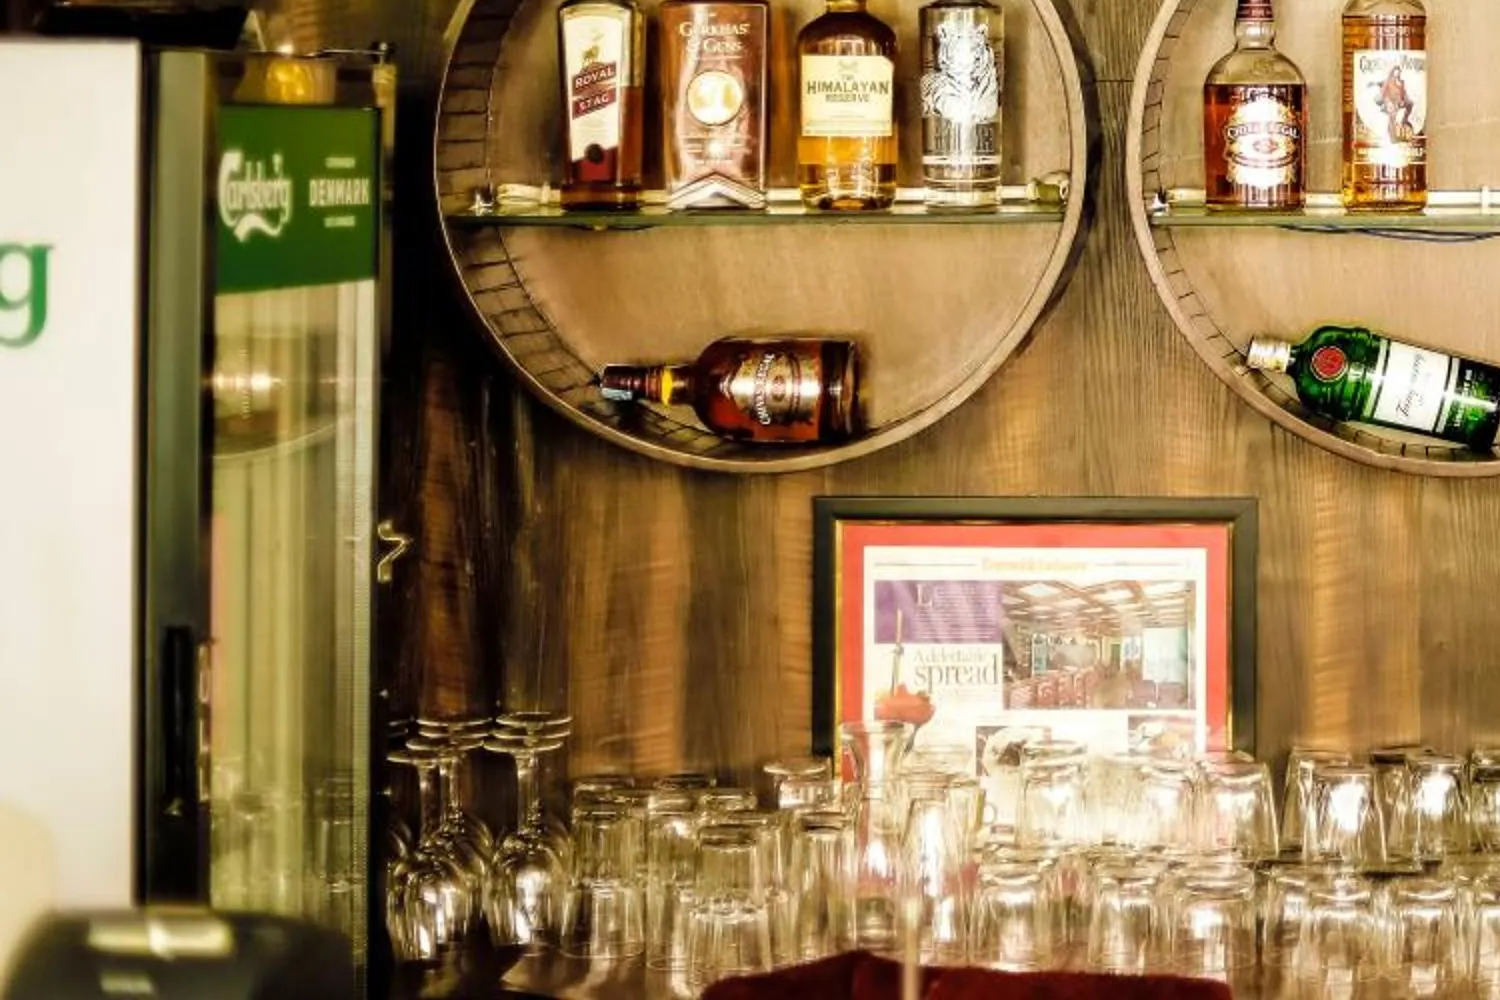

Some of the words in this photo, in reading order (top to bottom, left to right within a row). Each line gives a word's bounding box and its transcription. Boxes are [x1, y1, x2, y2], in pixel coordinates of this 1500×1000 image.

[574, 67, 615, 89] ROYAL
[807, 80, 890, 95] HIMALAYAN
[579, 96, 609, 112] STAG
[219, 151, 292, 241] Carlsberg
[309, 178, 370, 207] DENMARK
[914, 653, 998, 693] spread
